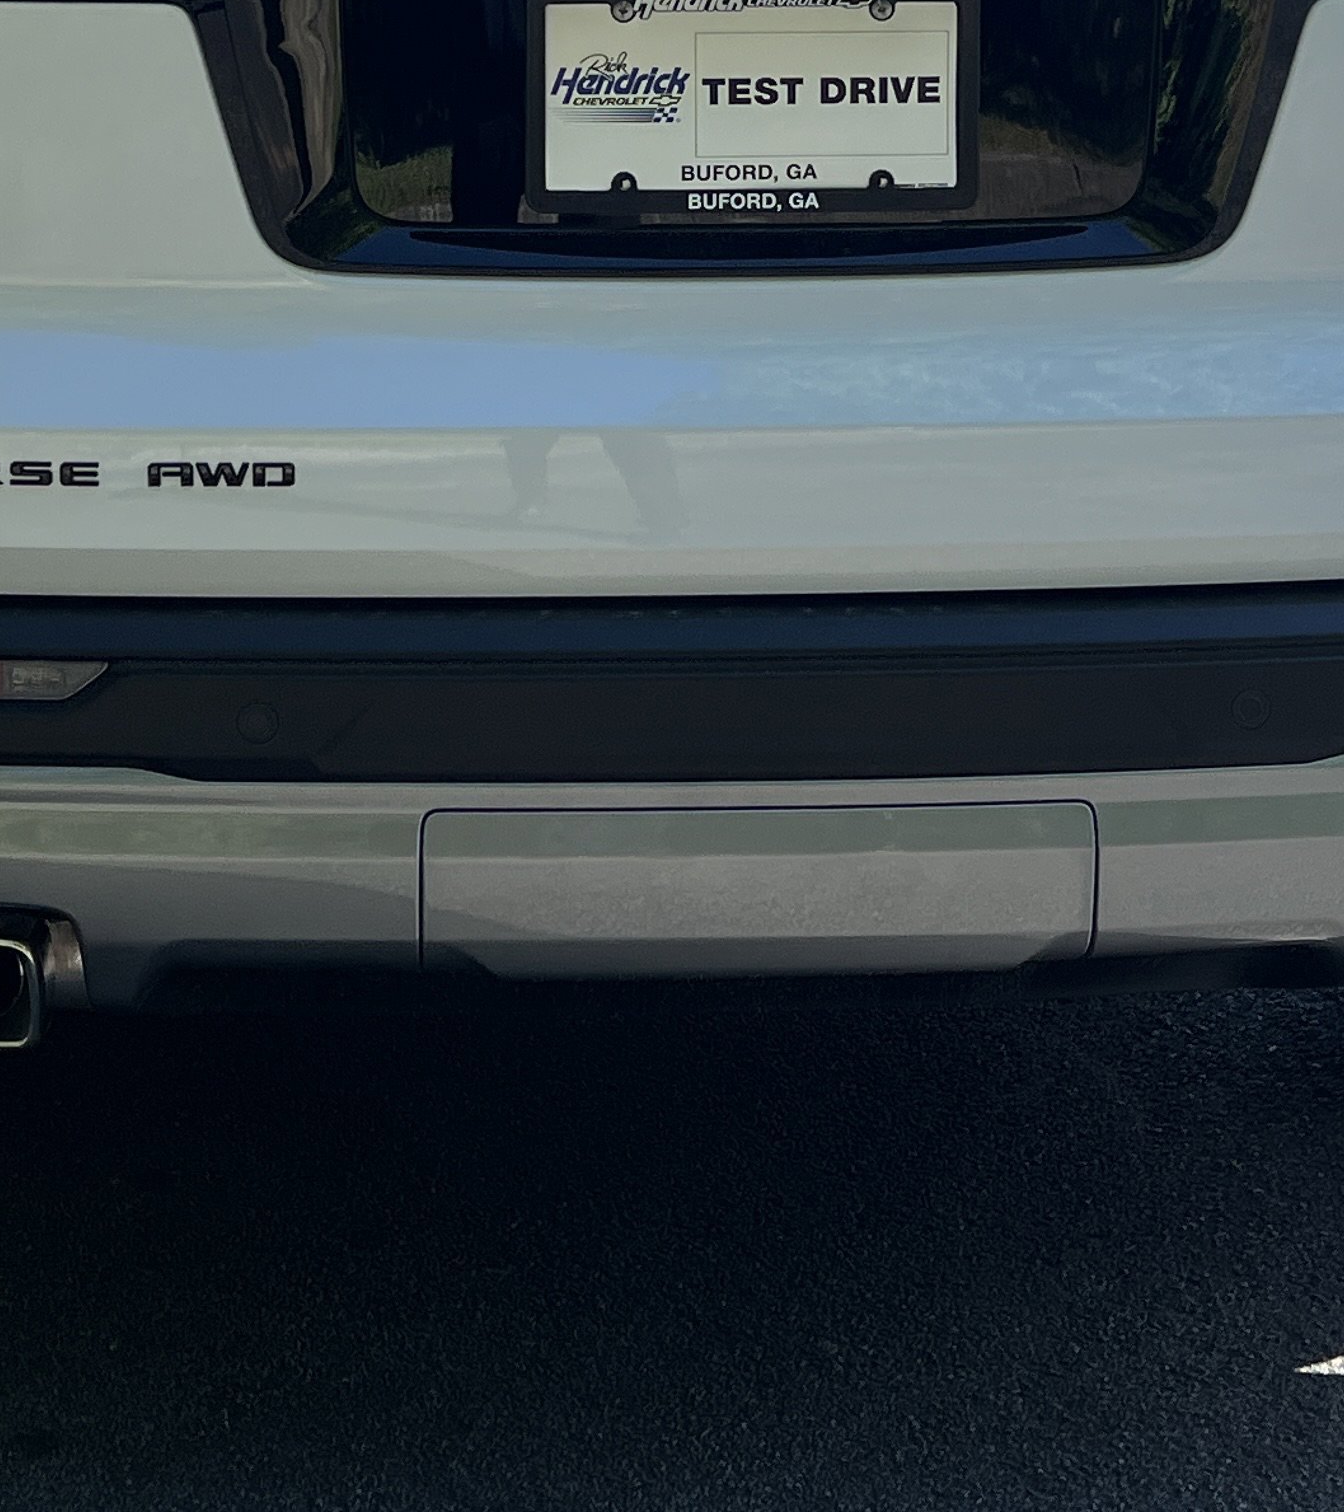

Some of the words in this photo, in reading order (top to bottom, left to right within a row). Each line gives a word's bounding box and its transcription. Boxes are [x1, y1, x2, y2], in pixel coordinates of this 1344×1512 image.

[579, 51, 629, 80] Rick
[550, 67, 691, 105] Hendrick
[702, 77, 804, 105] TEST
[820, 76, 942, 104] DRIVE
[572, 97, 649, 106] CHEVROLET
[681, 165, 779, 182] BUFORD,
[786, 164, 818, 180] GA
[687, 193, 783, 212] BUFORD,
[788, 192, 820, 210] GA
[147, 462, 297, 487] AWD
